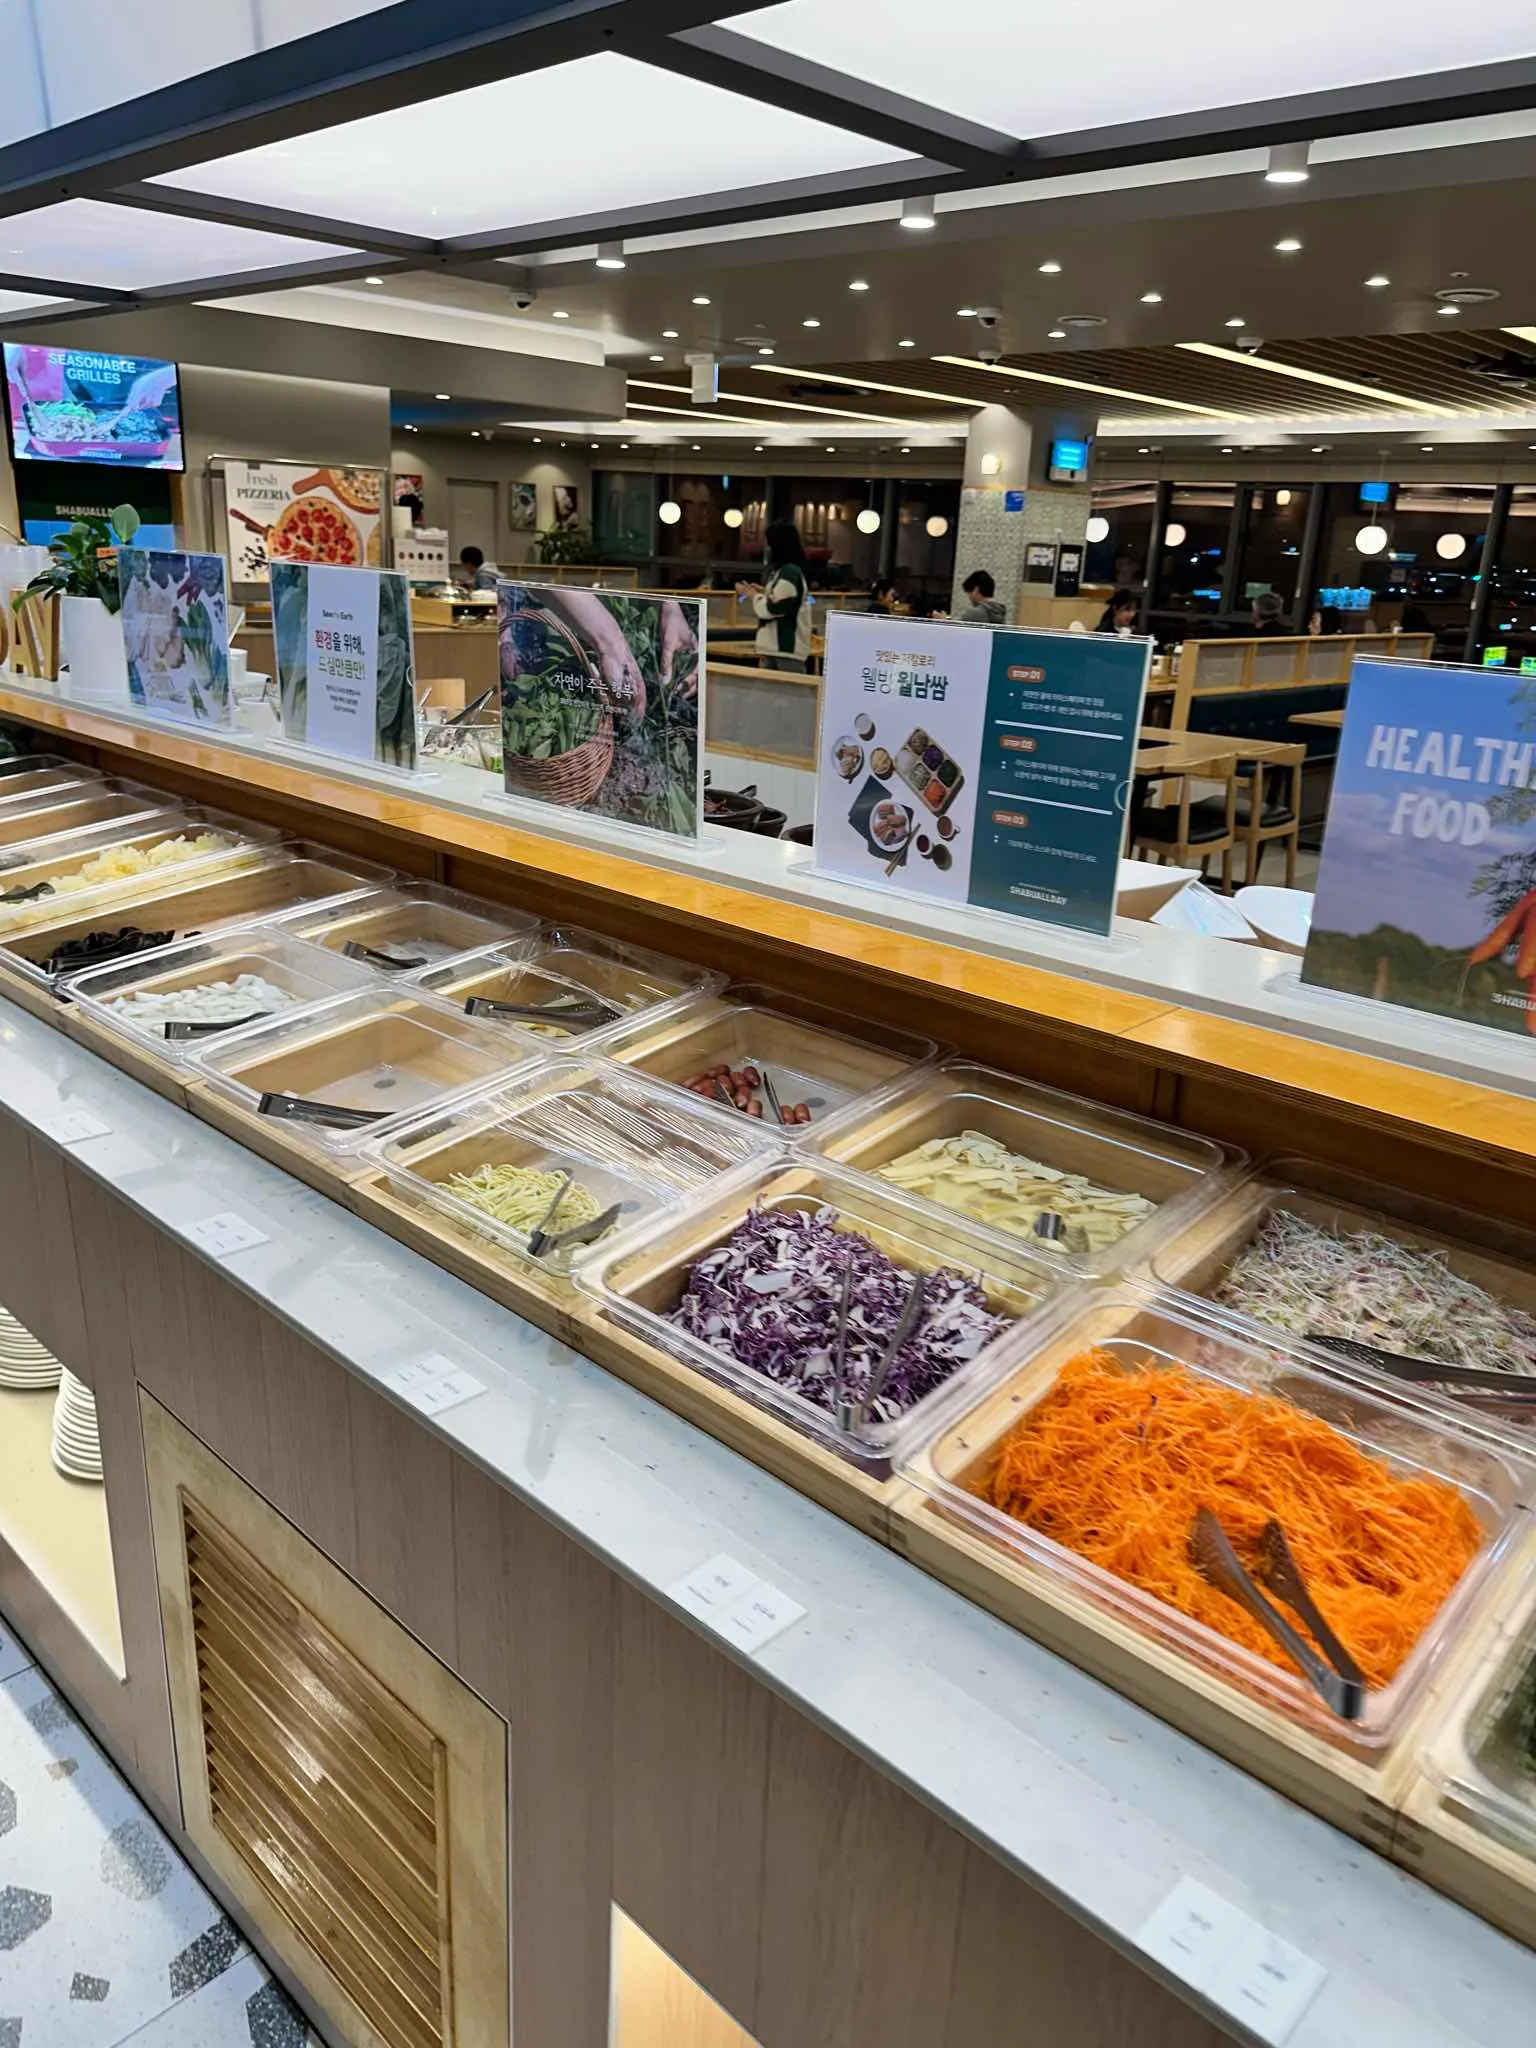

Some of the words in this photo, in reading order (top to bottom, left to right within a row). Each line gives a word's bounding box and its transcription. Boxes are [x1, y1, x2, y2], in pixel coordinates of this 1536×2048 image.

[48, 352, 137, 374] SEASONABLE
[66, 367, 122, 385] GRILLES
[246, 471, 278, 486] Fresh
[237, 487, 291, 501] PIZZERIA
[55, 505, 113, 518] SHABUALLD
[315, 629, 342, 652] 환경을
[553, 671, 584, 693] 자연이
[586, 678, 609, 696] 주는
[861, 666, 896, 695] 웰빙
[896, 671, 950, 702] 월남쌈
[1389, 792, 1491, 847] FOOD
